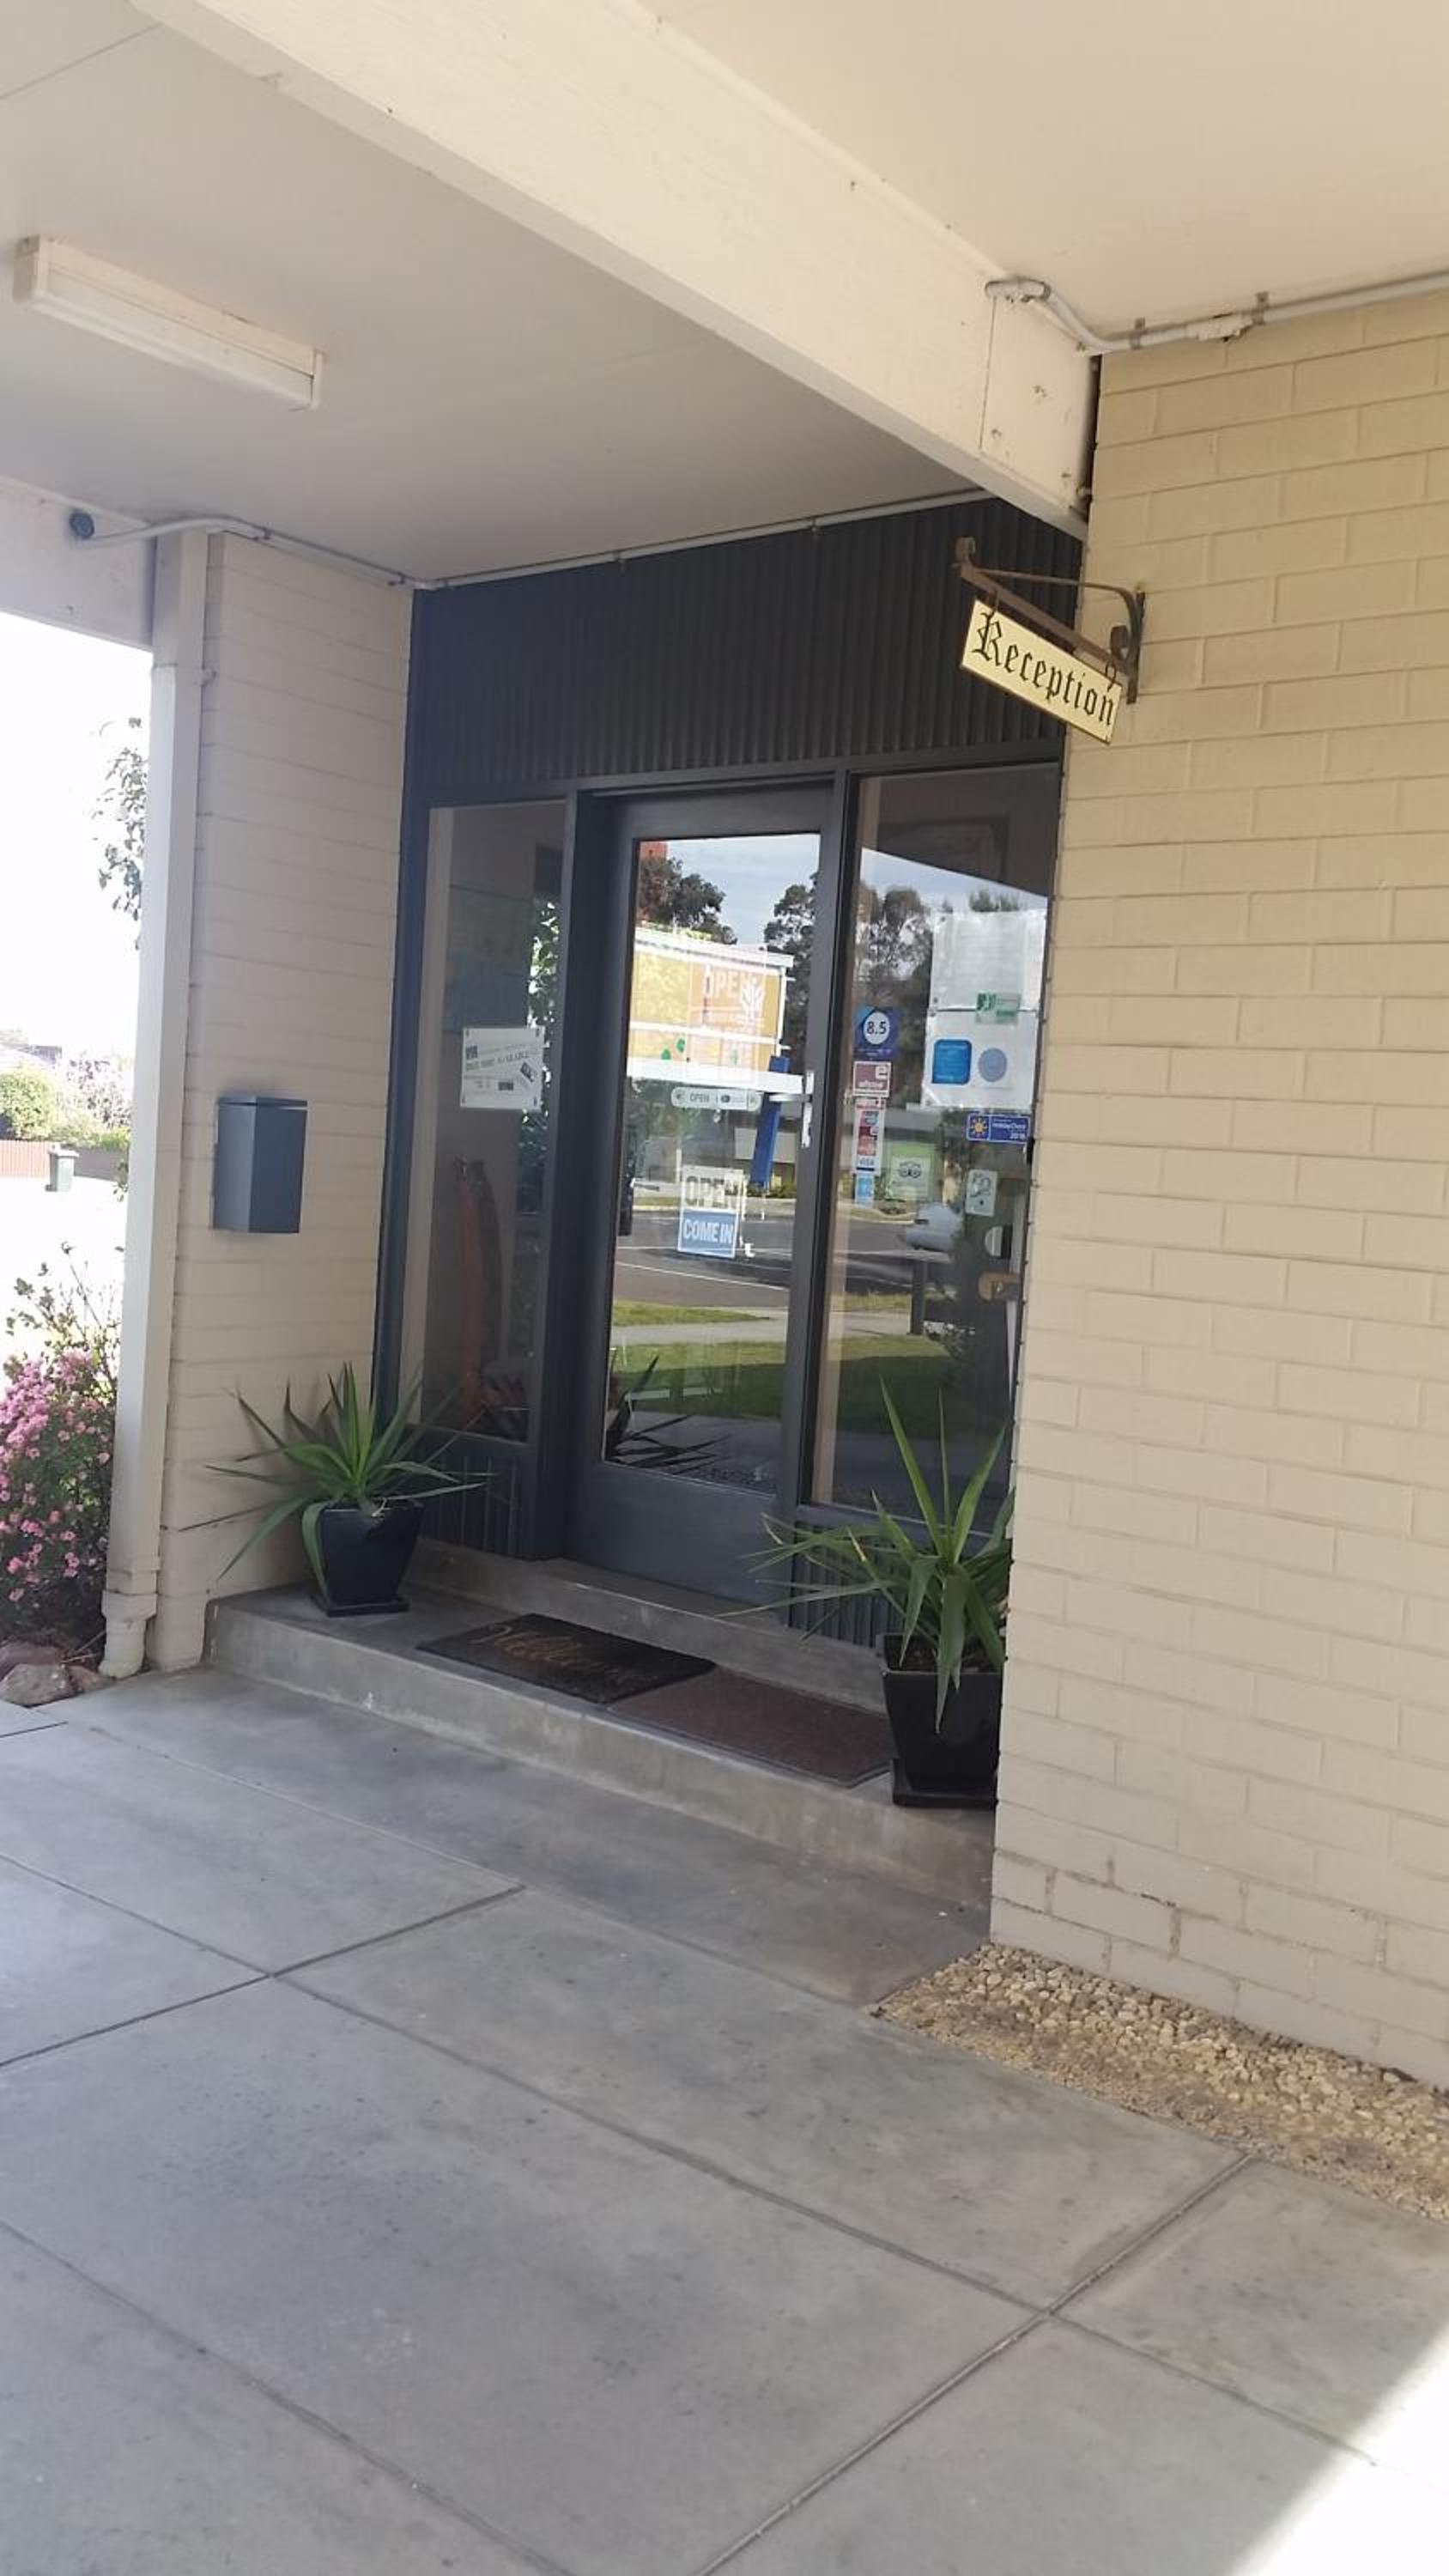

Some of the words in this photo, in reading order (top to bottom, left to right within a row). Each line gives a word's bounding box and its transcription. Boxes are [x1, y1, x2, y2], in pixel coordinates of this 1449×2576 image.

[971, 609, 1114, 726] Reception
[867, 1020, 886, 1035] 8.5
[686, 1176, 739, 1209] OPEN
[683, 1219, 718, 1242] COME
[719, 1224, 734, 1244] IN
